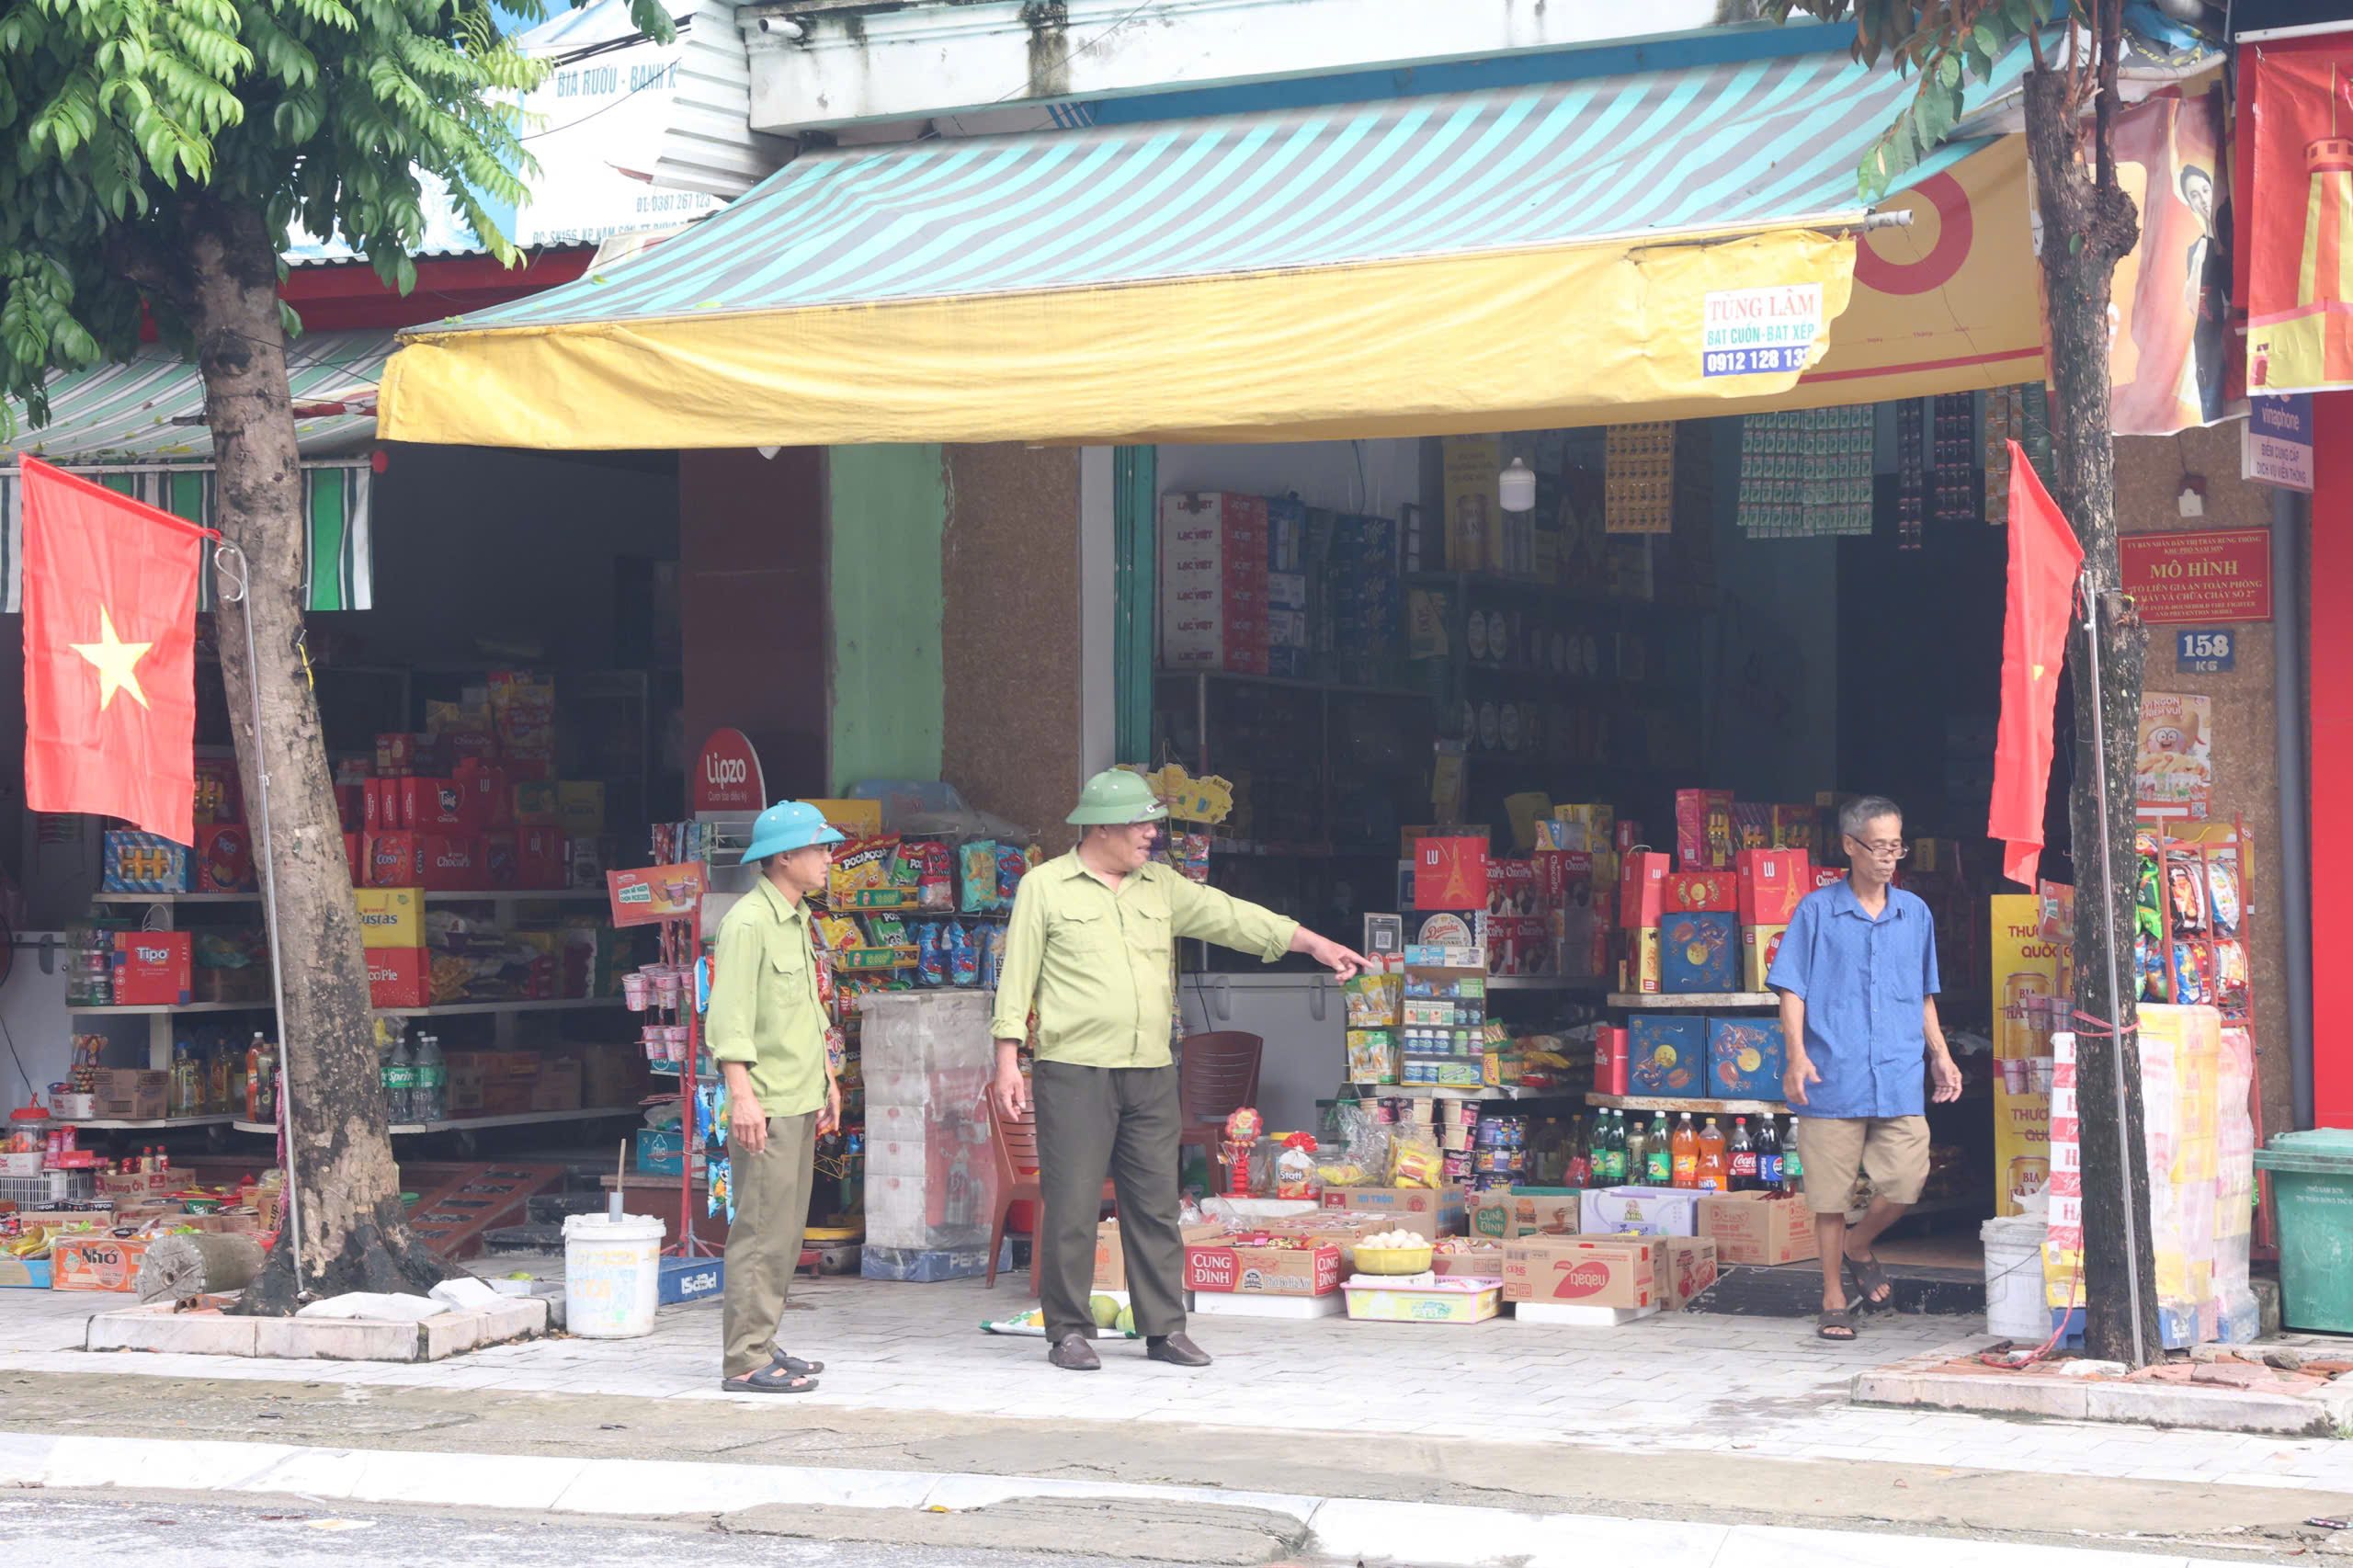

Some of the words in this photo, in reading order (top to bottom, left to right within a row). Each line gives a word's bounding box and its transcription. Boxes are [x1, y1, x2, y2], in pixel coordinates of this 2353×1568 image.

[558, 71, 578, 97] BIA
[652, 195, 674, 211] 0387
[677, 195, 692, 210] 267
[696, 192, 710, 208] 123
[1769, 289, 1815, 317] LÂM
[1708, 351, 1746, 373] 0912
[1750, 349, 1779, 369] 128
[2262, 403, 2300, 431] vinaphone
[2150, 559, 2182, 579] MÔ
[2188, 558, 2238, 577] HÌNH
[2170, 583, 2187, 591] GIA
[2188, 581, 2200, 590] AN
[2203, 579, 2228, 589] TOÀN
[2230, 578, 2263, 588] PHÒNG
[2184, 634, 2229, 657] 158
[706, 752, 746, 790] Lipzo
[377, 853, 398, 866] COSY
[1427, 849, 1438, 865] LU
[135, 946, 170, 963] Tipo
[368, 968, 398, 982] coPie
[2023, 1172, 2040, 1183] BIA
[94, 1202, 112, 1210] VIFON
[1478, 1210, 1505, 1222] CUNG
[949, 1250, 990, 1269] PEPS
[1192, 1253, 1232, 1268] CUNG
[1317, 1256, 1339, 1271] CUNG
[1195, 1268, 1231, 1284] ĐÌNH
[1318, 1271, 1337, 1287] ĐÌNH
[1570, 1270, 1607, 1287] nabati
